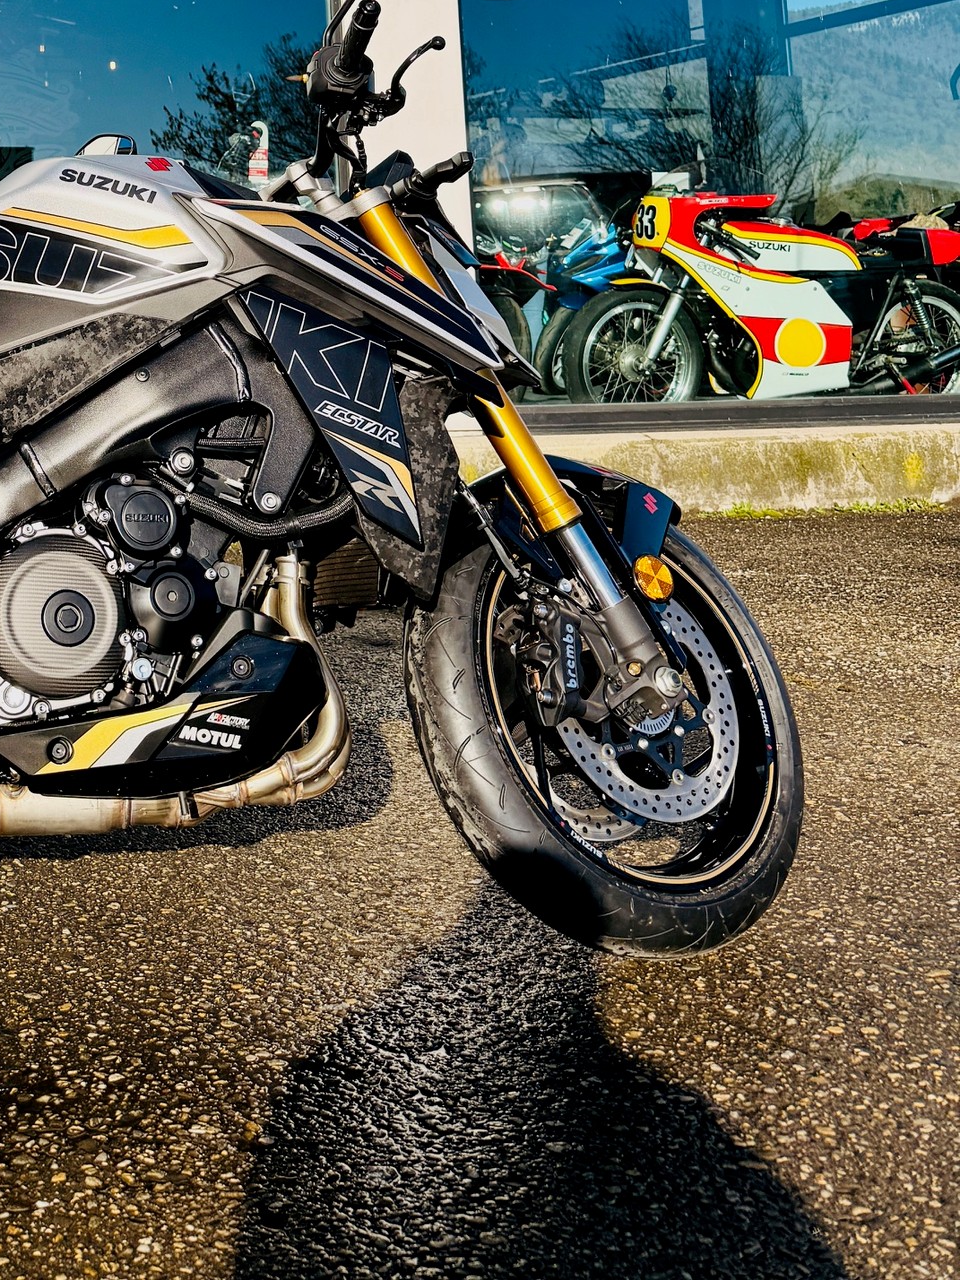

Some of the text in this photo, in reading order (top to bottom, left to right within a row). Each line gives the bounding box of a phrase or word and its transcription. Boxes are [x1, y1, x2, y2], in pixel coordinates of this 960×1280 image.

[59, 168, 157, 204] SUZUKI
[636, 204, 657, 240] 33
[320, 224, 404, 282] GSX-S
[749, 240, 791, 253] SUZUKI
[697, 261, 742, 285] SUZUKI
[314, 400, 401, 449] ECSTAR
[125, 513, 170, 524] SUZUKI
[562, 623, 578, 689] brembo
[756, 698, 772, 738] SUZUKI
[178, 725, 242, 750] MOTUL
[570, 829, 603, 859] SUZUKI
